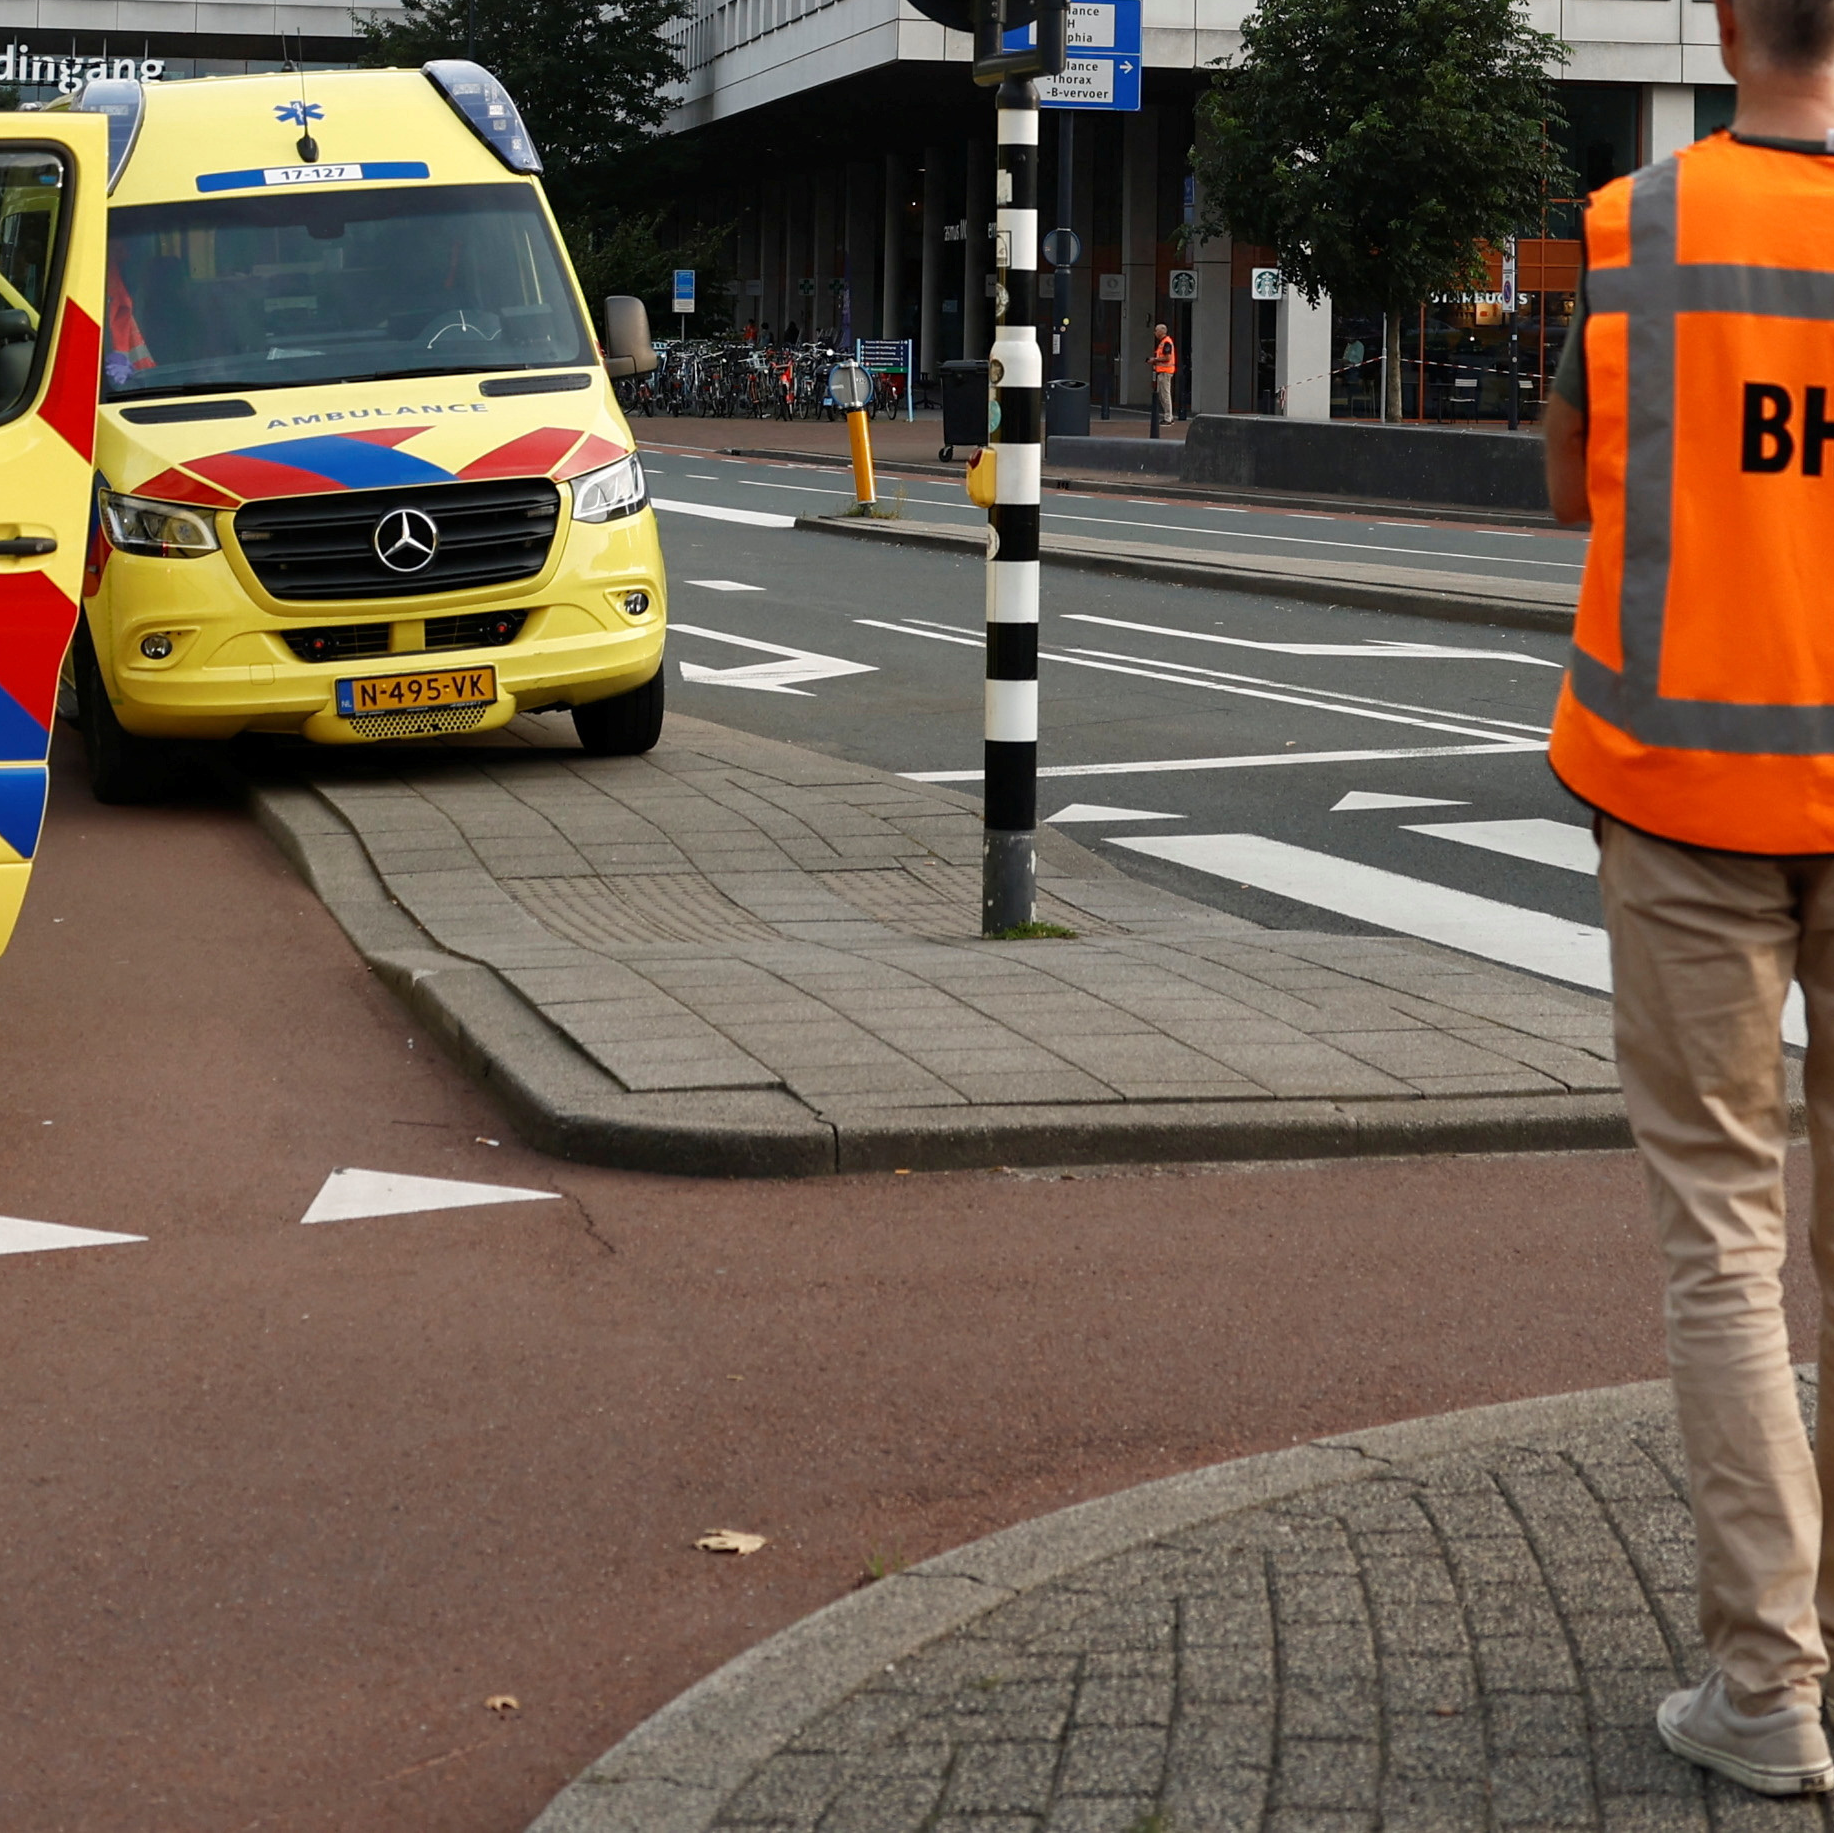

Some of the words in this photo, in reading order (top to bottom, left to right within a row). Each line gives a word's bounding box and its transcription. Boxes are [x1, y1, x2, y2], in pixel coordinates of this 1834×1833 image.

[1067, 61, 1098, 71] lance
[1047, 88, 1109, 99] -B-vervoer
[281, 168, 345, 180] 17-127
[267, 403, 489, 429] AMBULANCE
[341, 700, 352, 709] NL
[361, 674, 485, 707] N-495-VK
